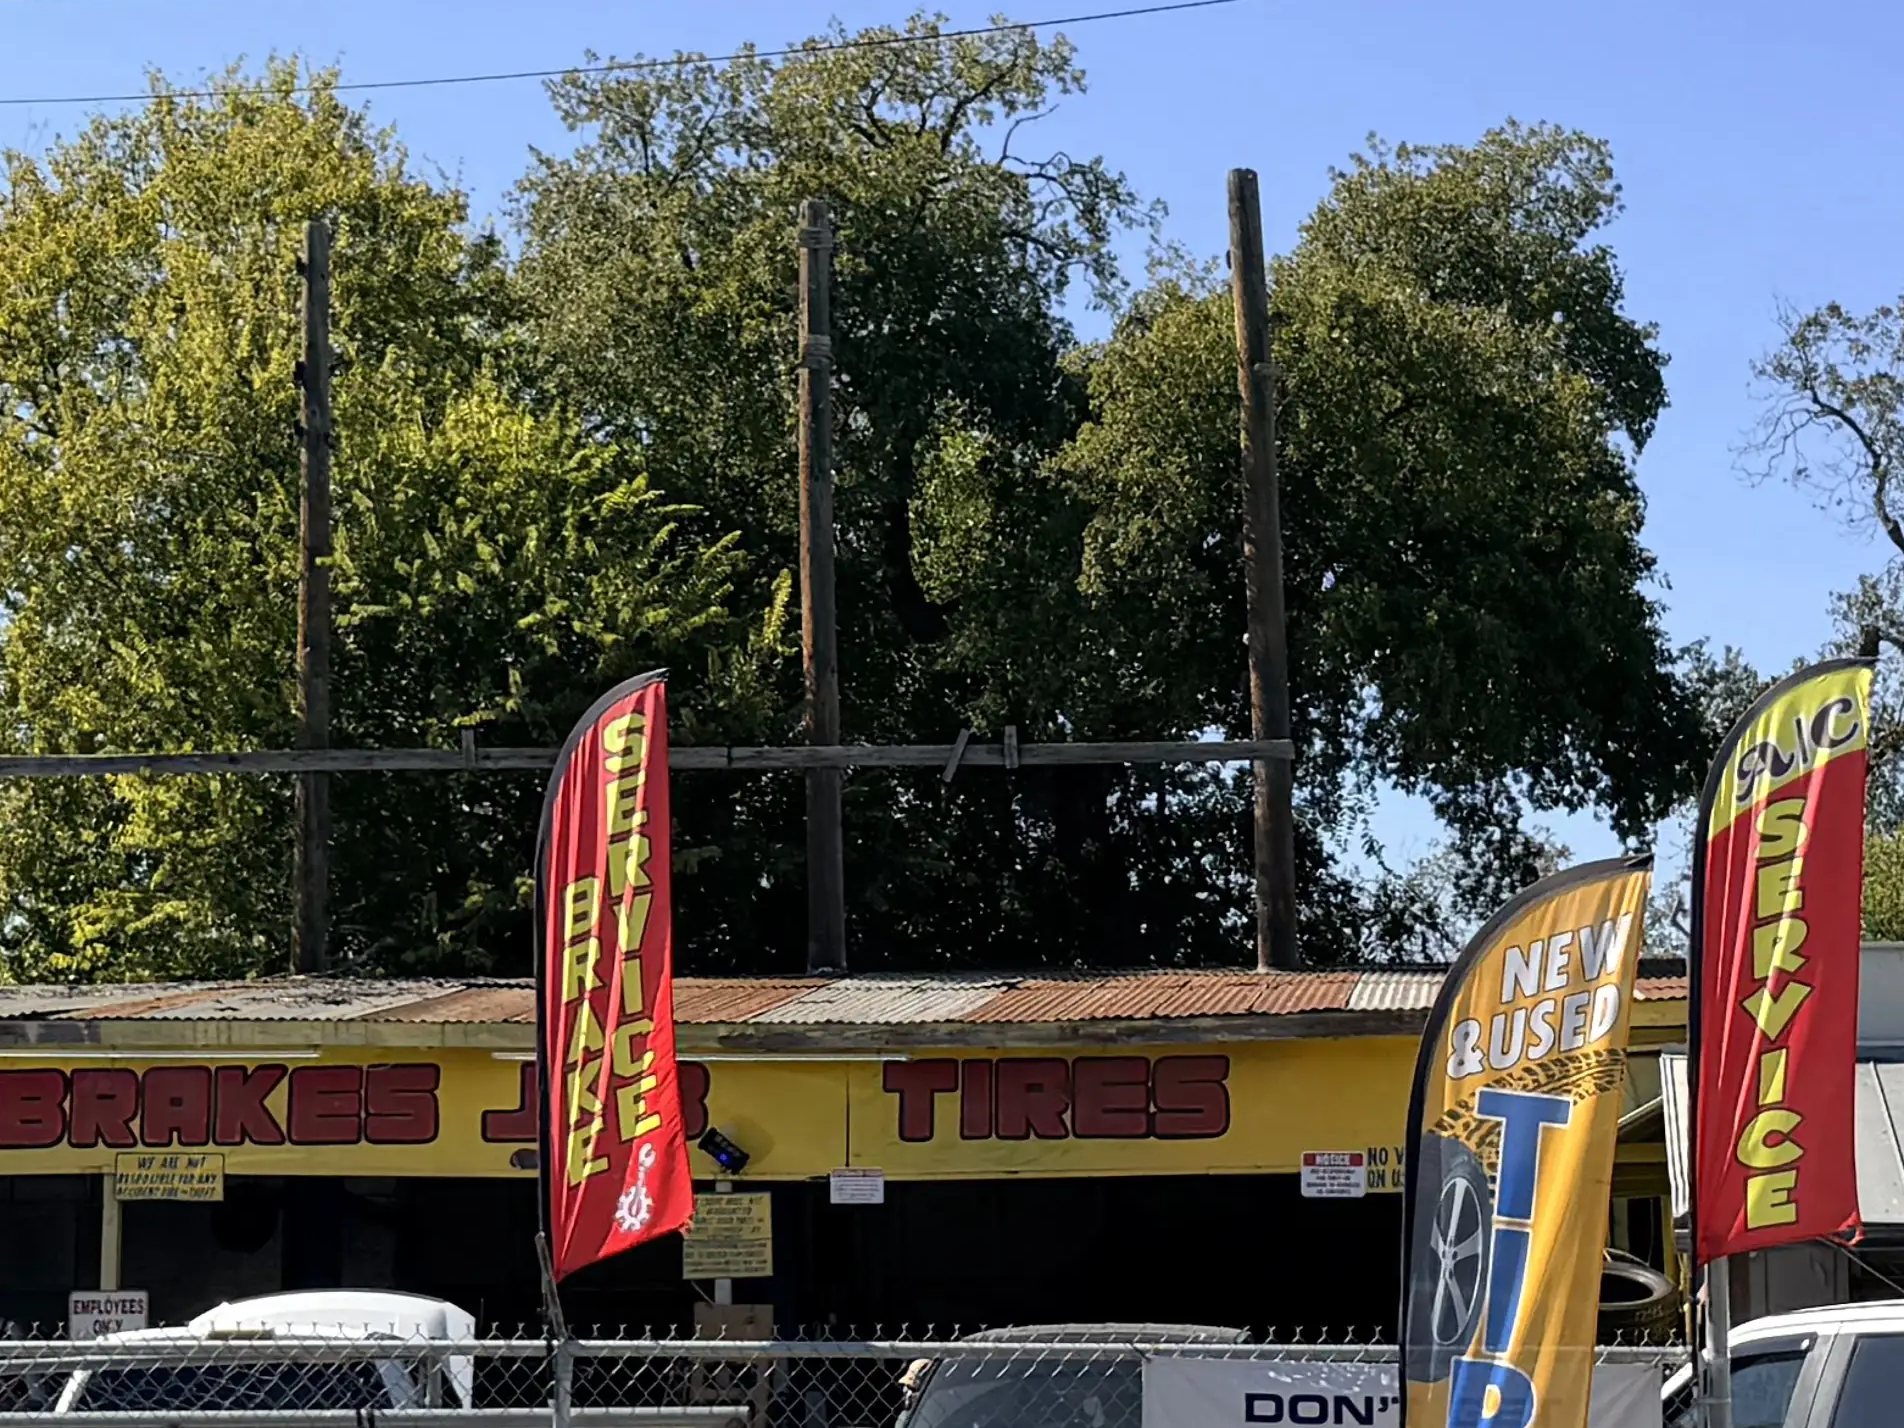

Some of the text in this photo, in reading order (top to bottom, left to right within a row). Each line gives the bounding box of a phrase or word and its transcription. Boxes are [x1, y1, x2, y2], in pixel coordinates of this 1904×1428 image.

[1736, 696, 1860, 804] A/C
[603, 712, 661, 1143] SERVICE
[1501, 912, 1633, 1004] NEW
[562, 876, 609, 1189] BRAKE
[1735, 795, 1815, 1232] SERVICE
[883, 1054, 1230, 1143] TIRES
[1367, 1147, 1389, 1166] NO
[73, 1298, 145, 1315] EMPLOYEES
